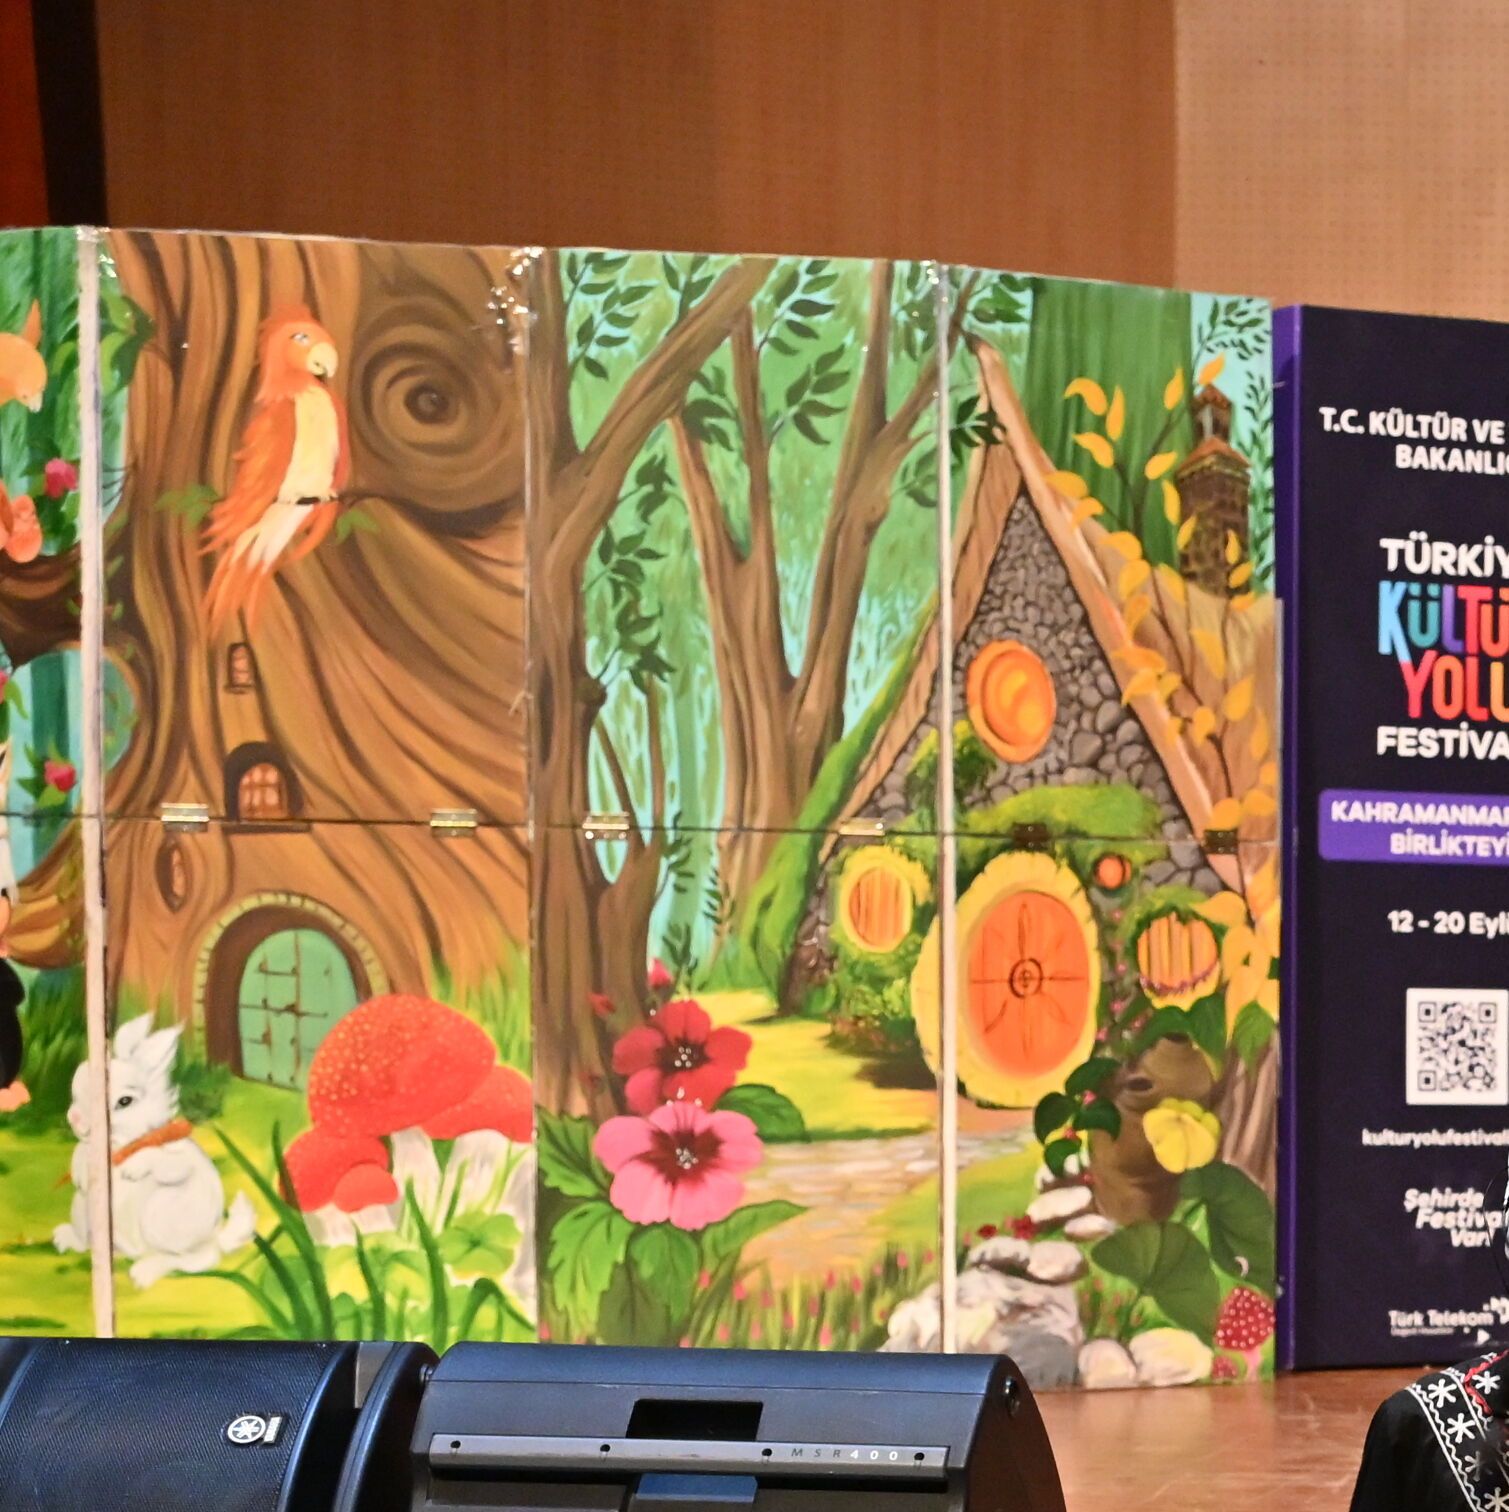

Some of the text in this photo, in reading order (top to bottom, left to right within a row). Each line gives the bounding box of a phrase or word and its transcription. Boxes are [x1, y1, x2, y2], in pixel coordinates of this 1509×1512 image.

[1318, 406, 1366, 434] T.C.
[1368, 407, 1468, 442] KÜLTÜR
[1471, 418, 1507, 445] VE
[1387, 909, 1414, 933] 12
[1433, 910, 1466, 935] 20
[1403, 1187, 1485, 1213] Şehirde
[1388, 1309, 1495, 1328] Türk Telekom
